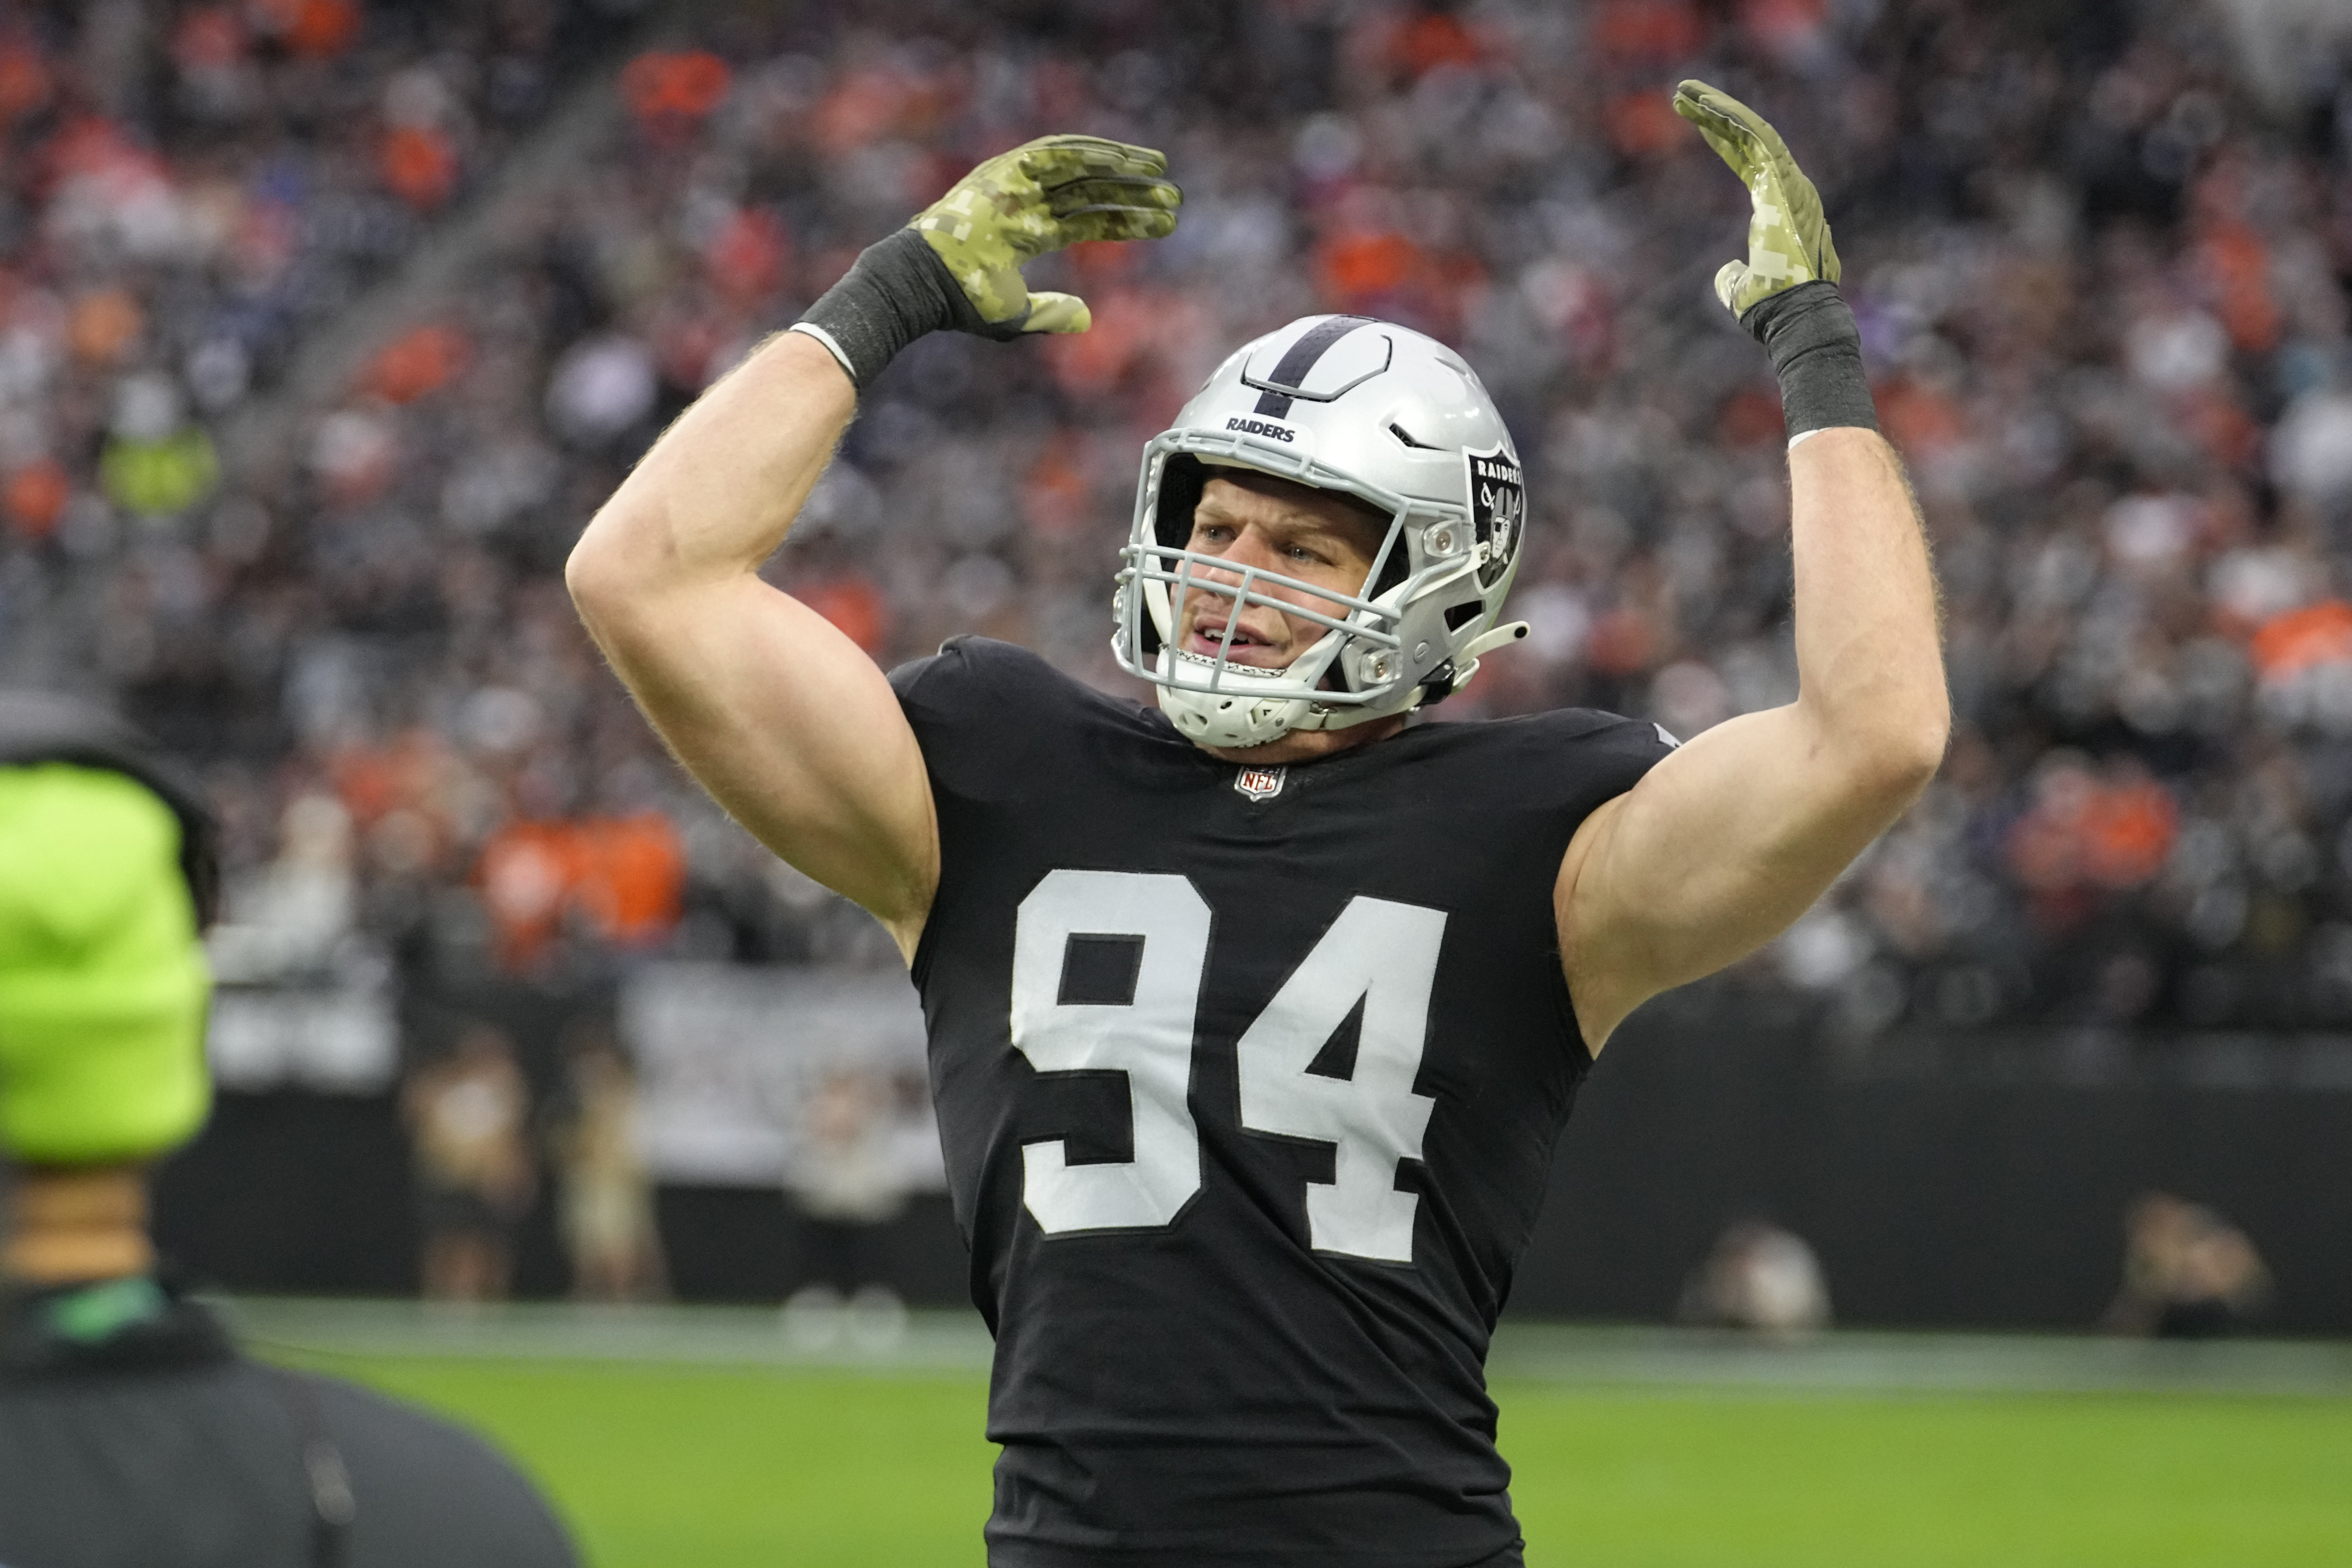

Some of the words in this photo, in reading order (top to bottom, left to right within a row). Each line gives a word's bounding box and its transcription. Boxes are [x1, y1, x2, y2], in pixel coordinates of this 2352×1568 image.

[1226, 417, 1296, 442] RAIDERS
[1243, 772, 1273, 791] NFL
[1010, 869, 1448, 1262] 94
